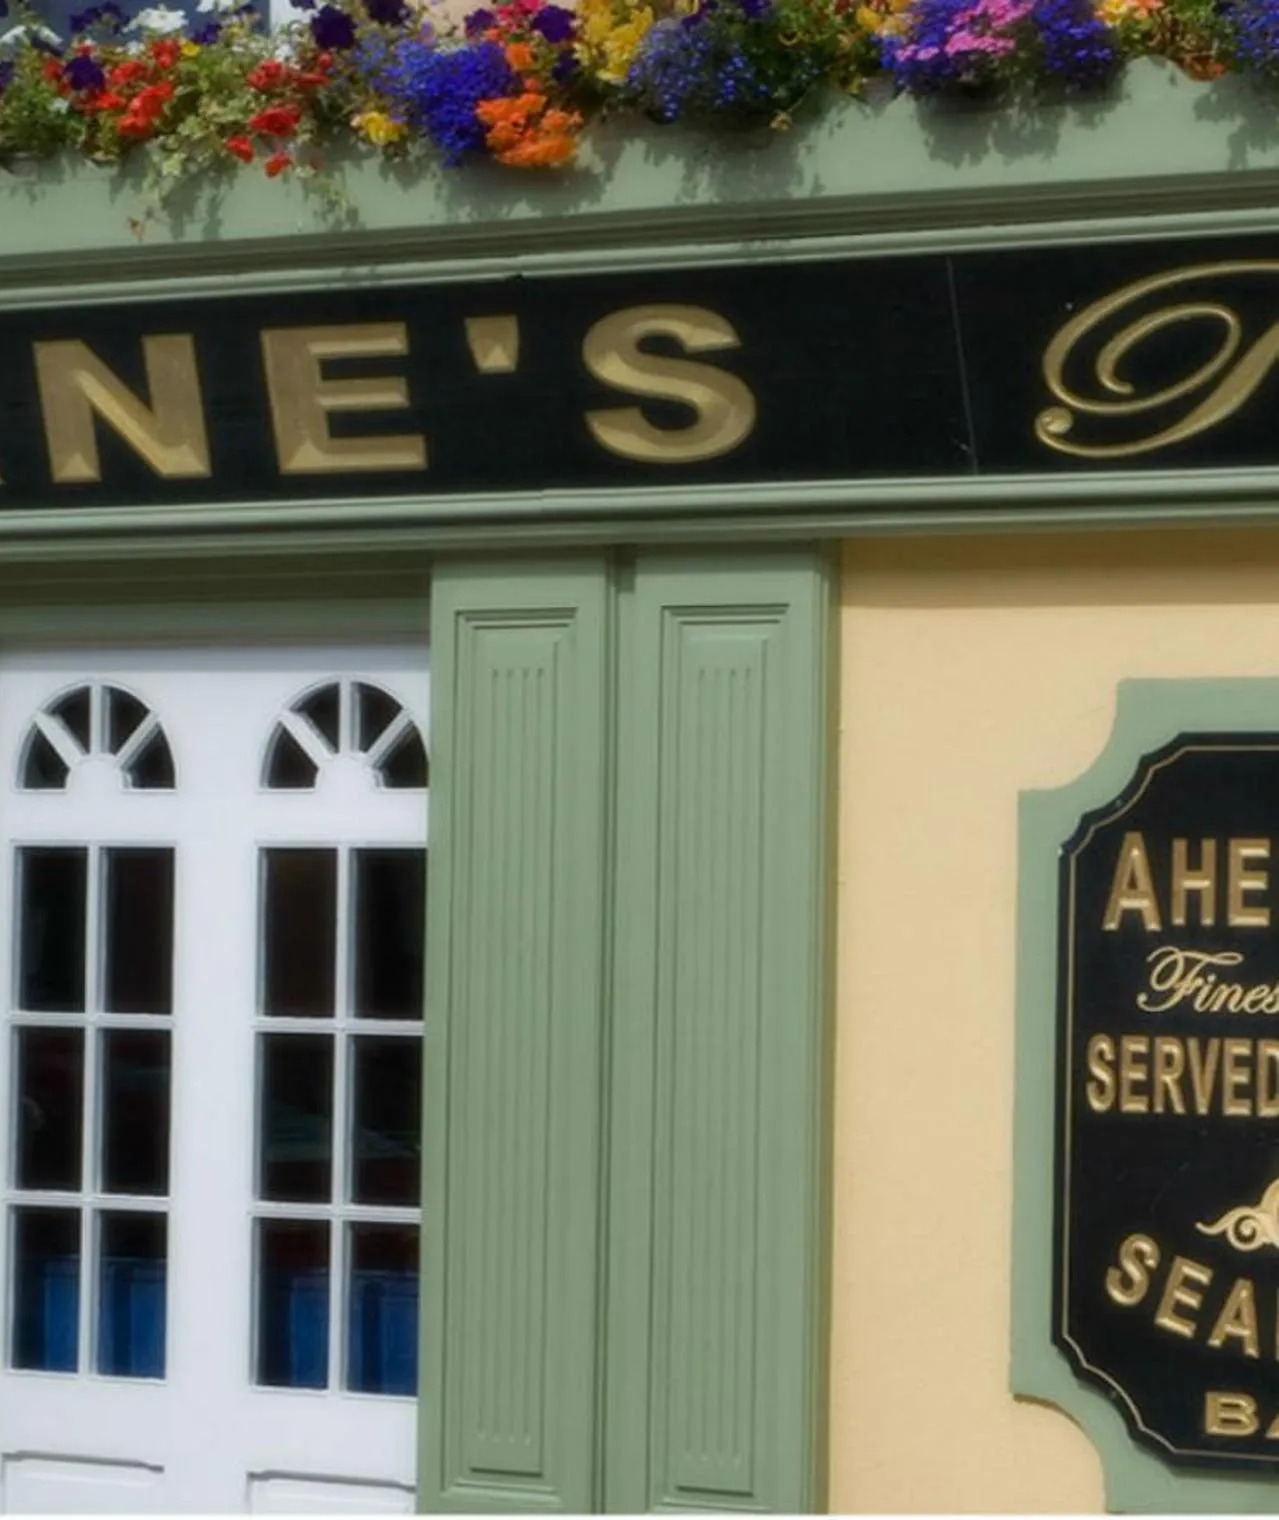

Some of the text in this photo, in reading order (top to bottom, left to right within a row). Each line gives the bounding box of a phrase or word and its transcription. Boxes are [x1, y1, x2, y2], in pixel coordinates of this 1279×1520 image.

[1102, 831, 1271, 931] AHE
[1086, 1033, 1279, 1117] SERVED
[1105, 1233, 1279, 1360] SEA
[1205, 1391, 1279, 1439] B
